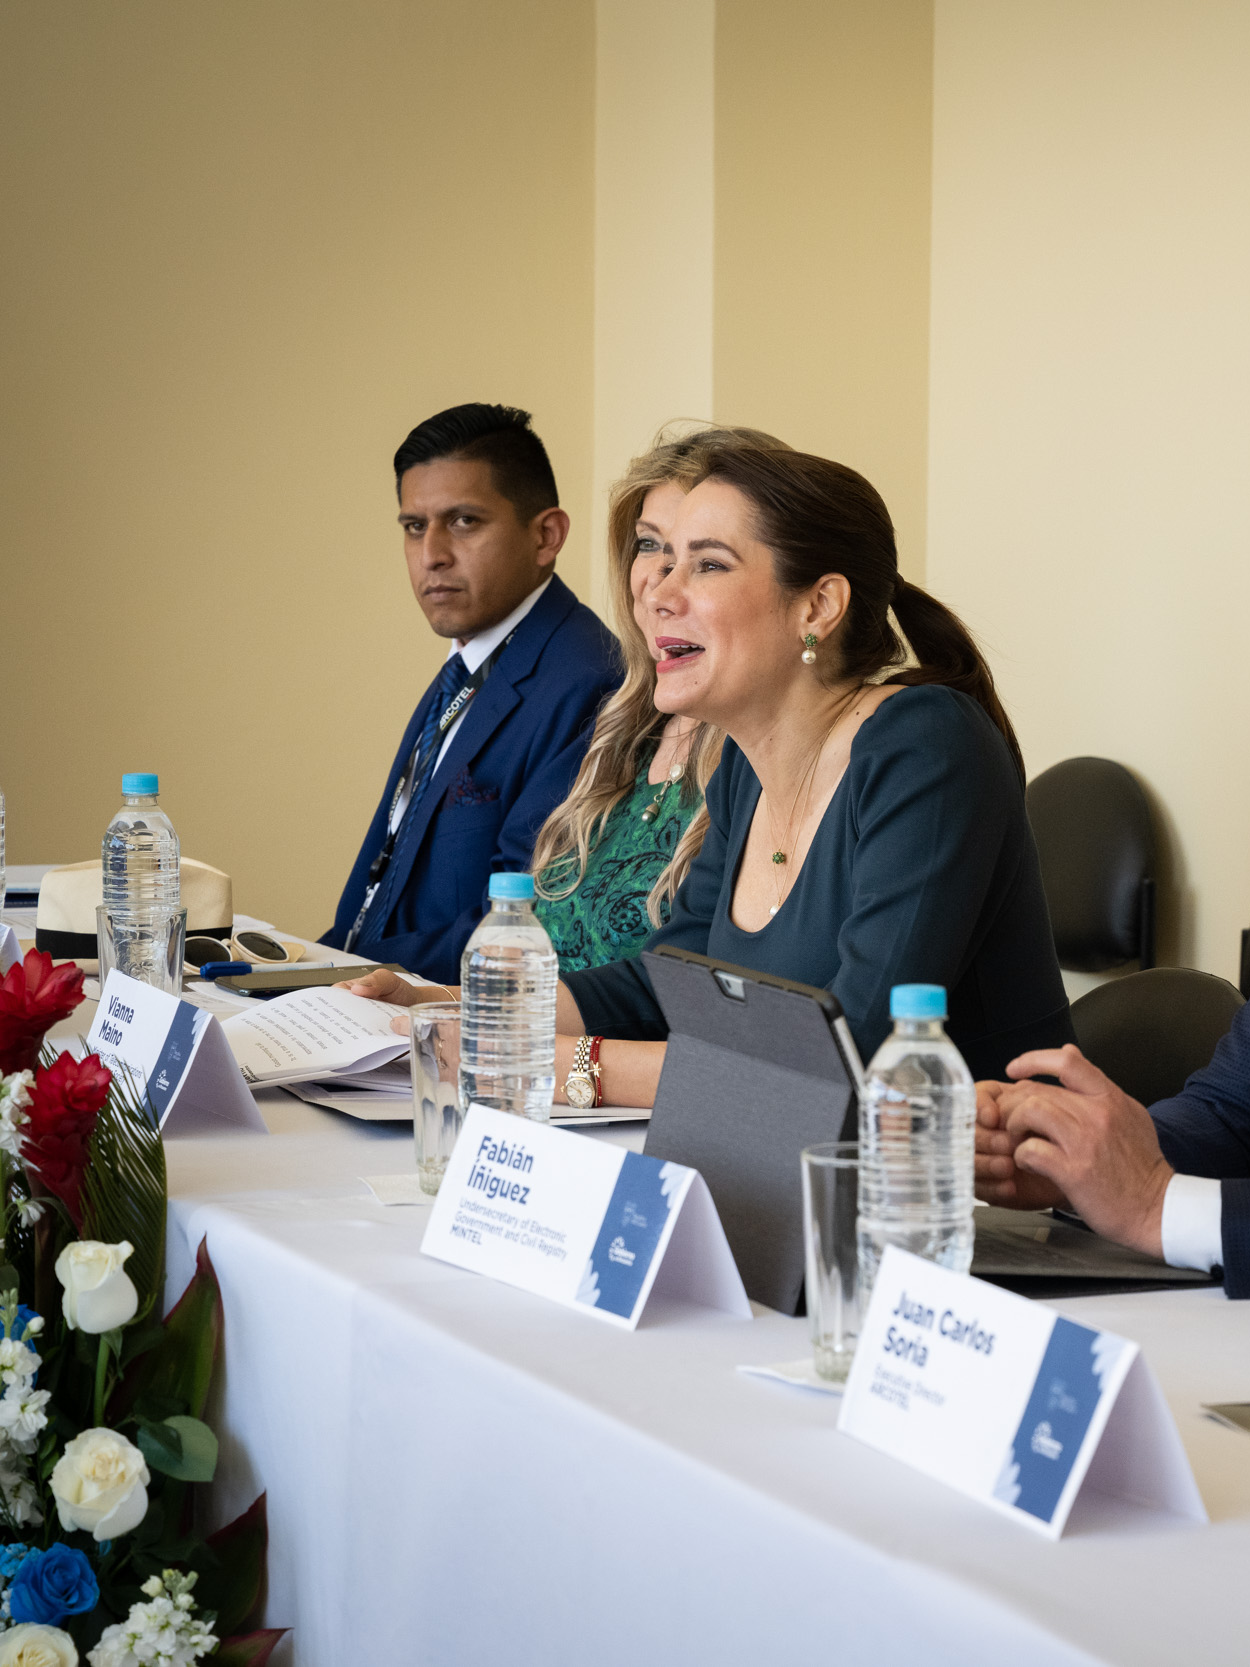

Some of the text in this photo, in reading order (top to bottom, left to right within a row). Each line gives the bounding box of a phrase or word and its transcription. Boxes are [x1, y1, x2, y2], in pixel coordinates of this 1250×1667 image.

[440, 686, 474, 729] ARCOTEL
[108, 995, 134, 1024] Vianna
[99, 1019, 123, 1046] Maino
[477, 1135, 534, 1174] Fabián
[467, 1158, 531, 1205] Íñiguez
[450, 1223, 482, 1245] MINTEL
[454, 1210, 568, 1261] Government and Civil Registry
[459, 1198, 567, 1243] Undersecretary of Electronic
[893, 1290, 995, 1355] Juan Carlos
[883, 1326, 928, 1367] Soria
